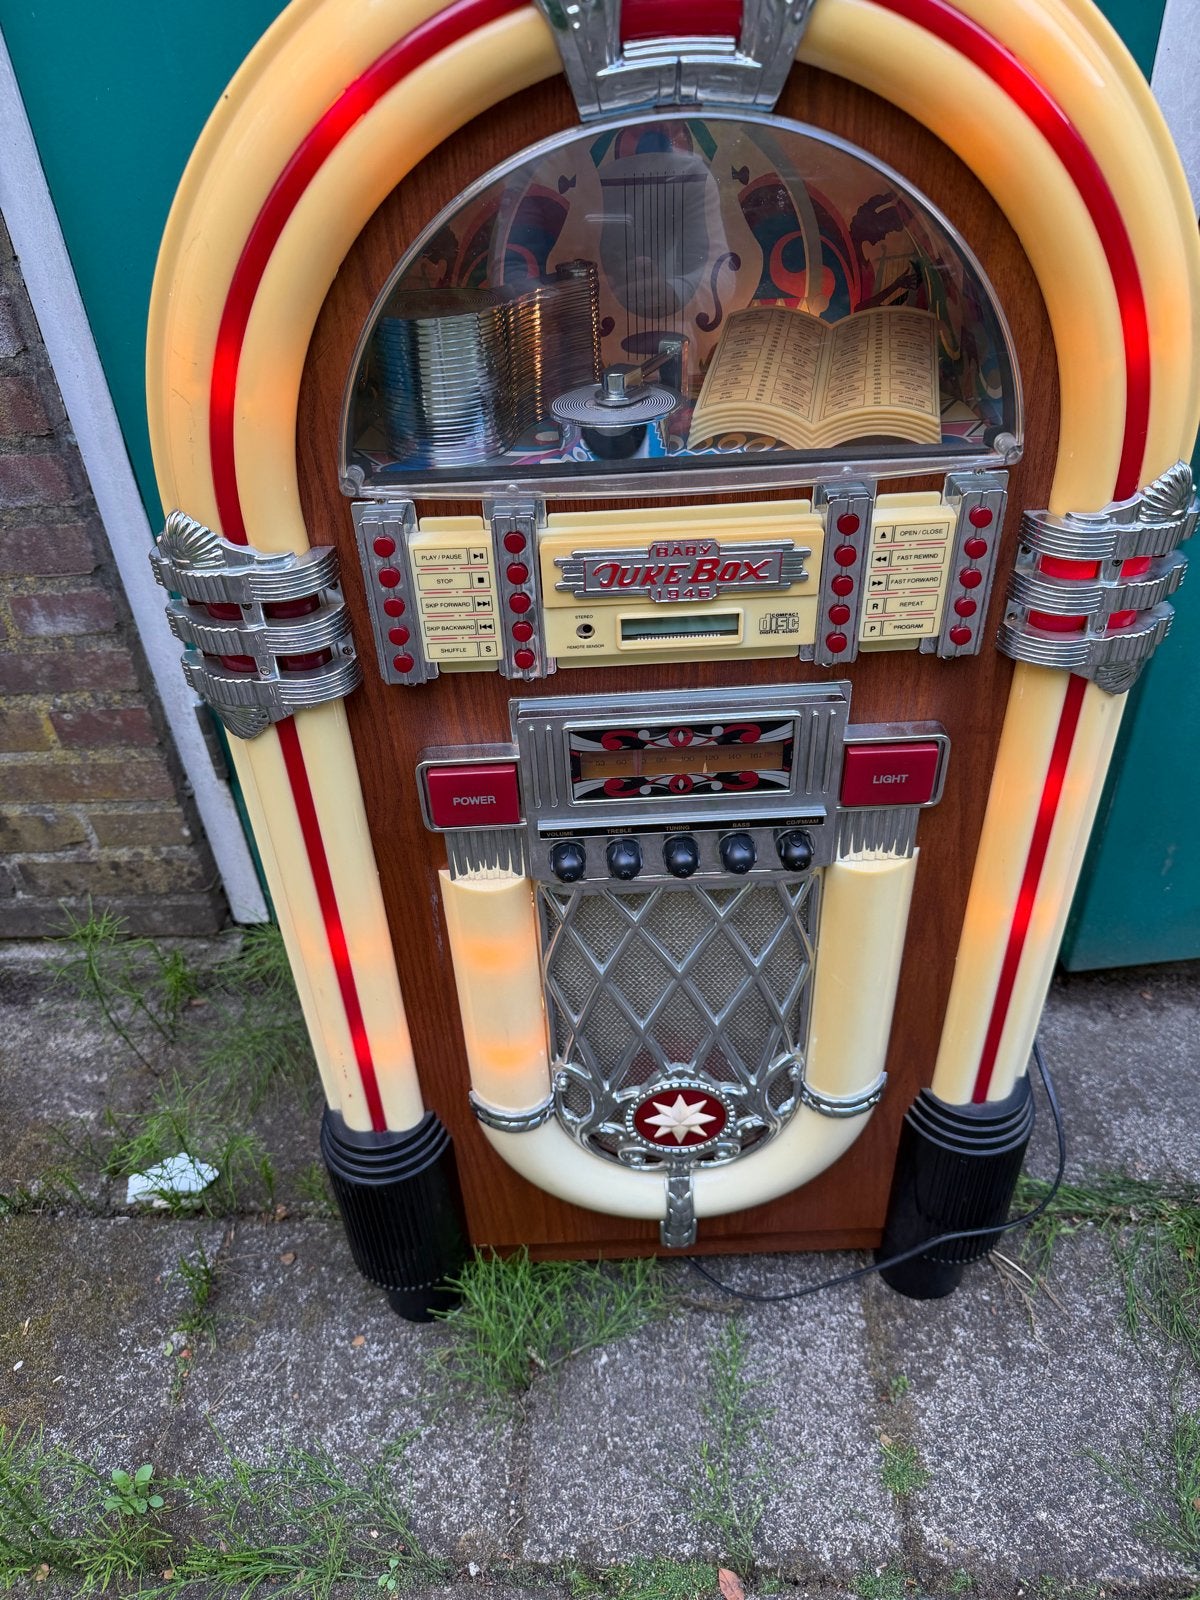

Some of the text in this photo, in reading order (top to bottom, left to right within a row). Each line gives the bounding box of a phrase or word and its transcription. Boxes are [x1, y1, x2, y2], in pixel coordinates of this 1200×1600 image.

[655, 544, 712, 557] BABY
[592, 557, 773, 588] JUKE BOX
[656, 586, 711, 600] 1946
[872, 774, 908, 784] LIGHT
[452, 796, 496, 806] POWER
